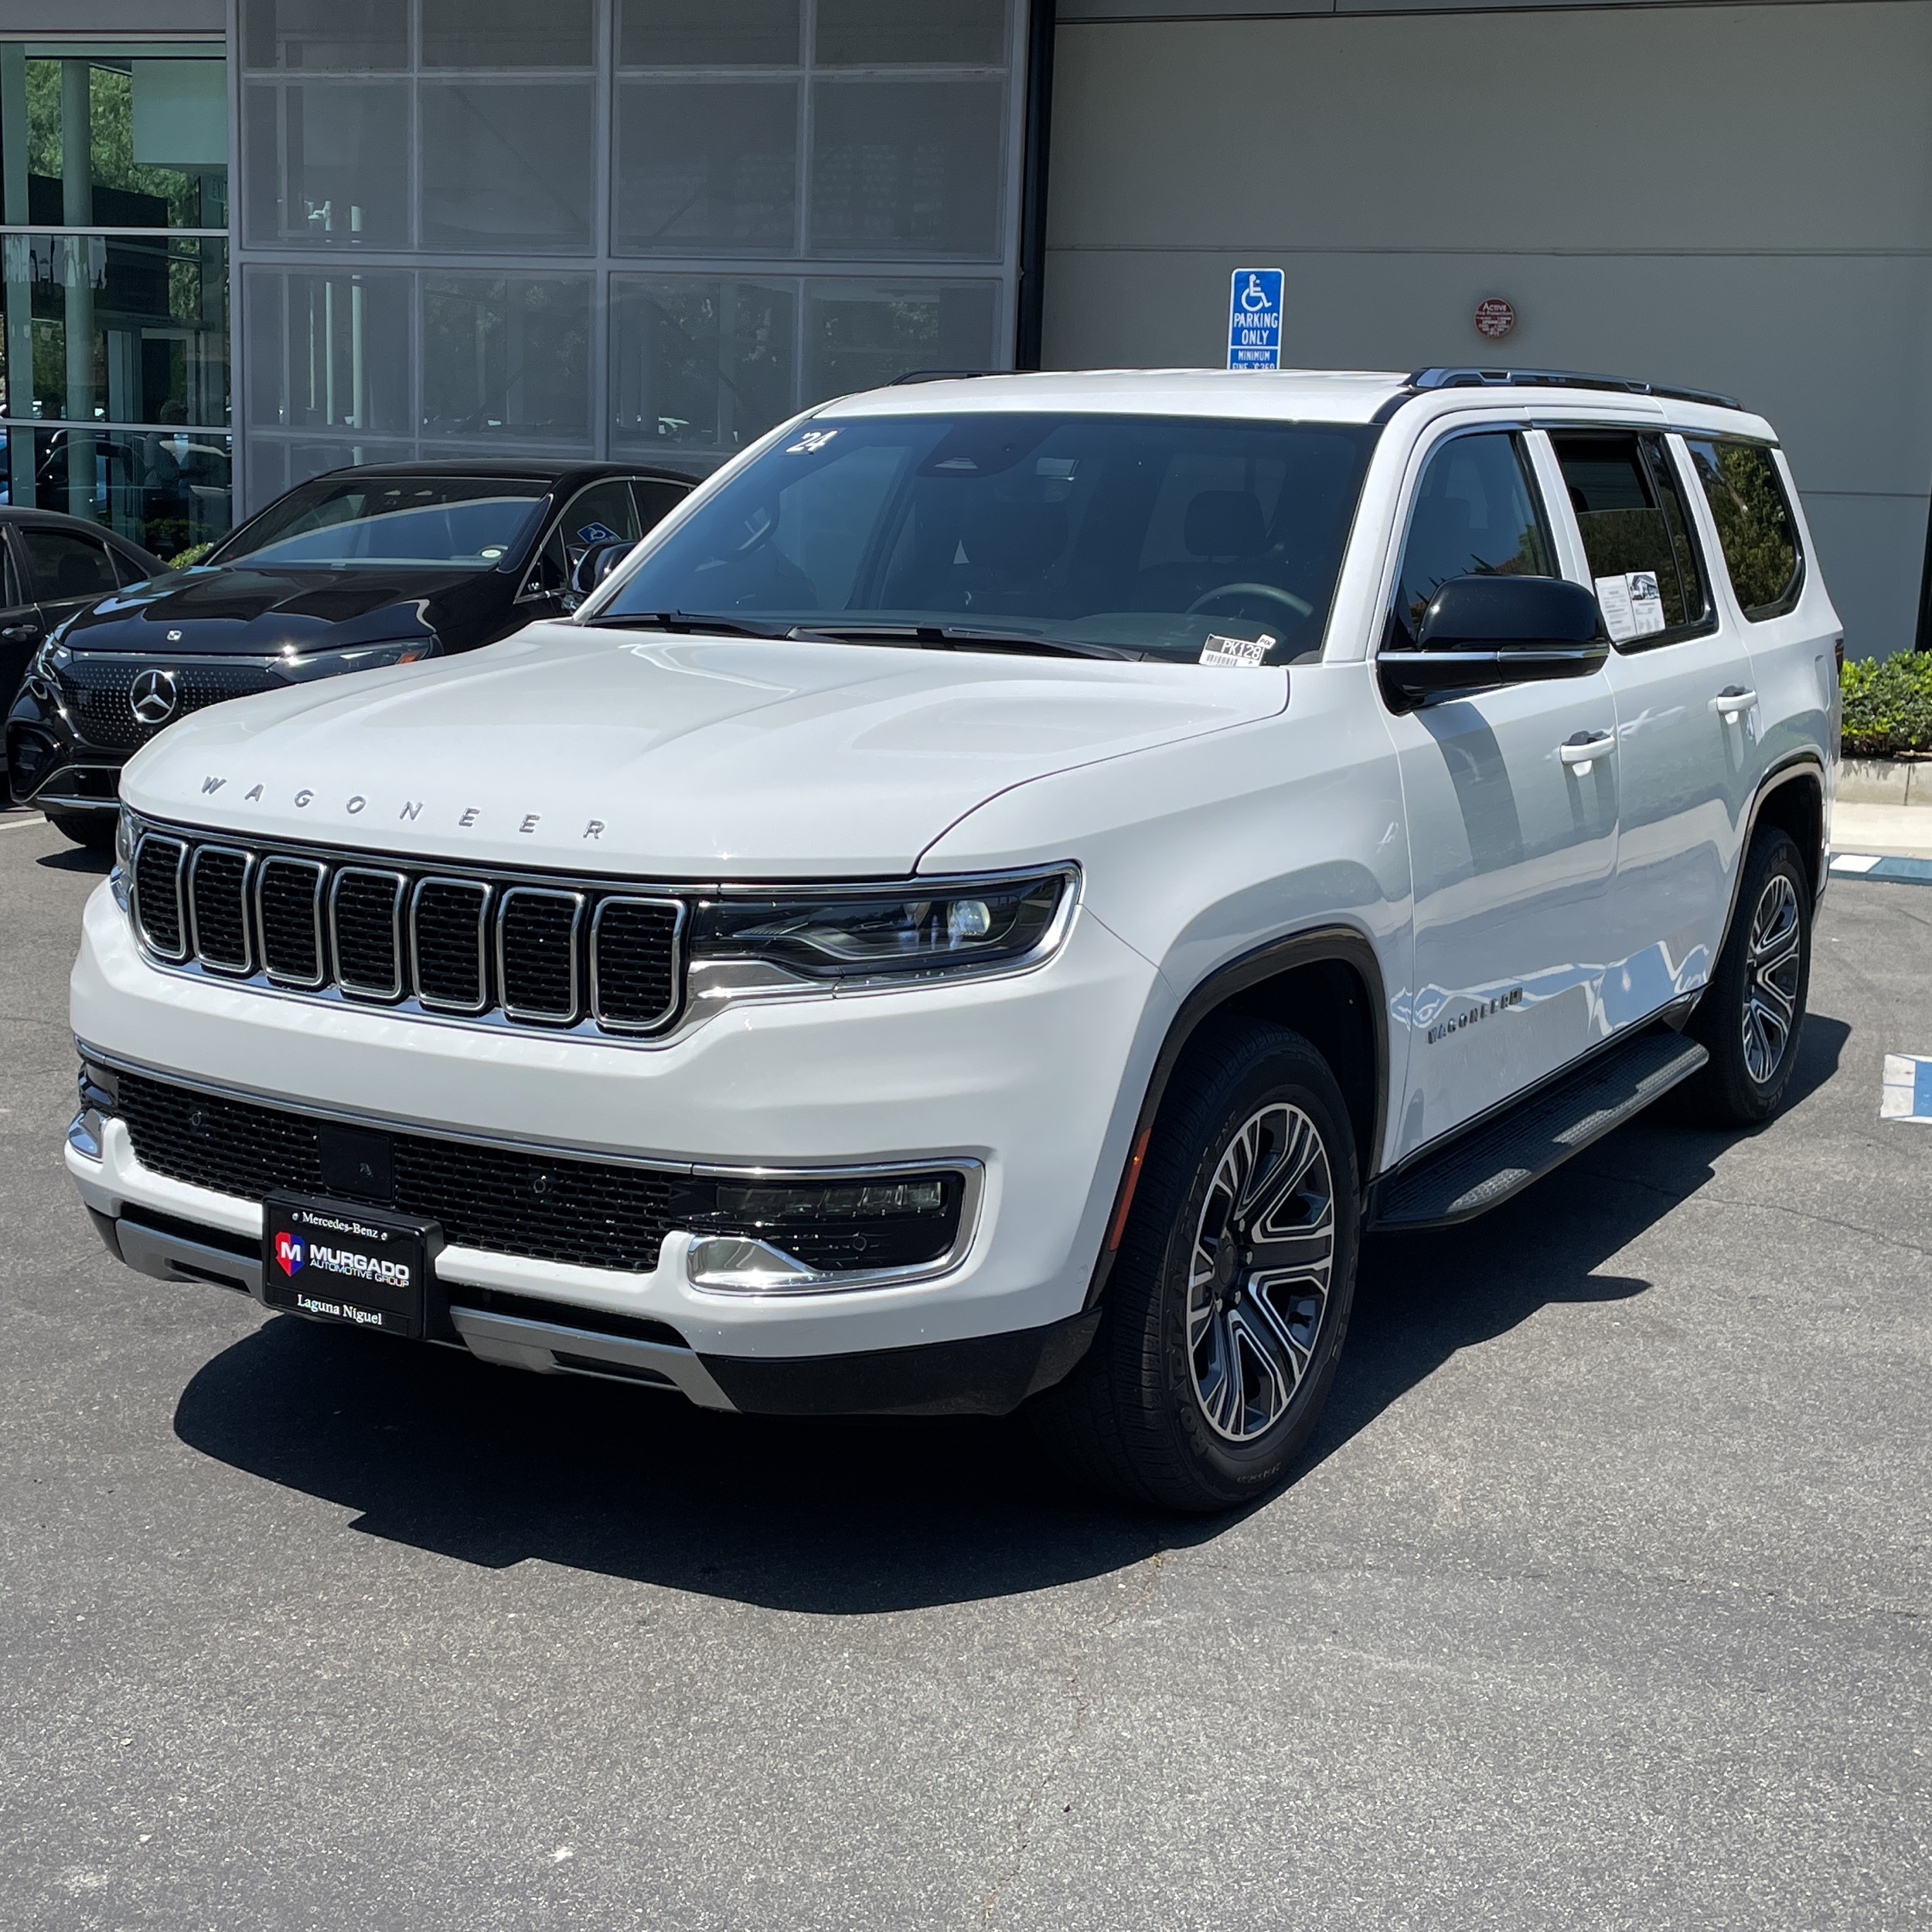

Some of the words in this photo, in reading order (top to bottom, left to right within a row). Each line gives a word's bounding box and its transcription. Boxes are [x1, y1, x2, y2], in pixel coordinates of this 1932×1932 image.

[1234, 312, 1278, 328] PARKING
[1242, 329, 1269, 345] ONLY
[1238, 350, 1270, 360] MINIMUM
[1221, 640, 1261, 660] PK128
[199, 775, 607, 840] WAGONEER
[1427, 993, 1509, 1044] WAGONEER
[302, 1212, 378, 1239] Mercedes-Benz
[281, 1242, 302, 1262] M
[310, 1244, 409, 1279] MURGADO
[309, 1259, 373, 1280] AUTOMOTIVE
[374, 1272, 410, 1287] GROUP
[297, 1294, 340, 1316] Laguna
[342, 1304, 383, 1325] Niguel
